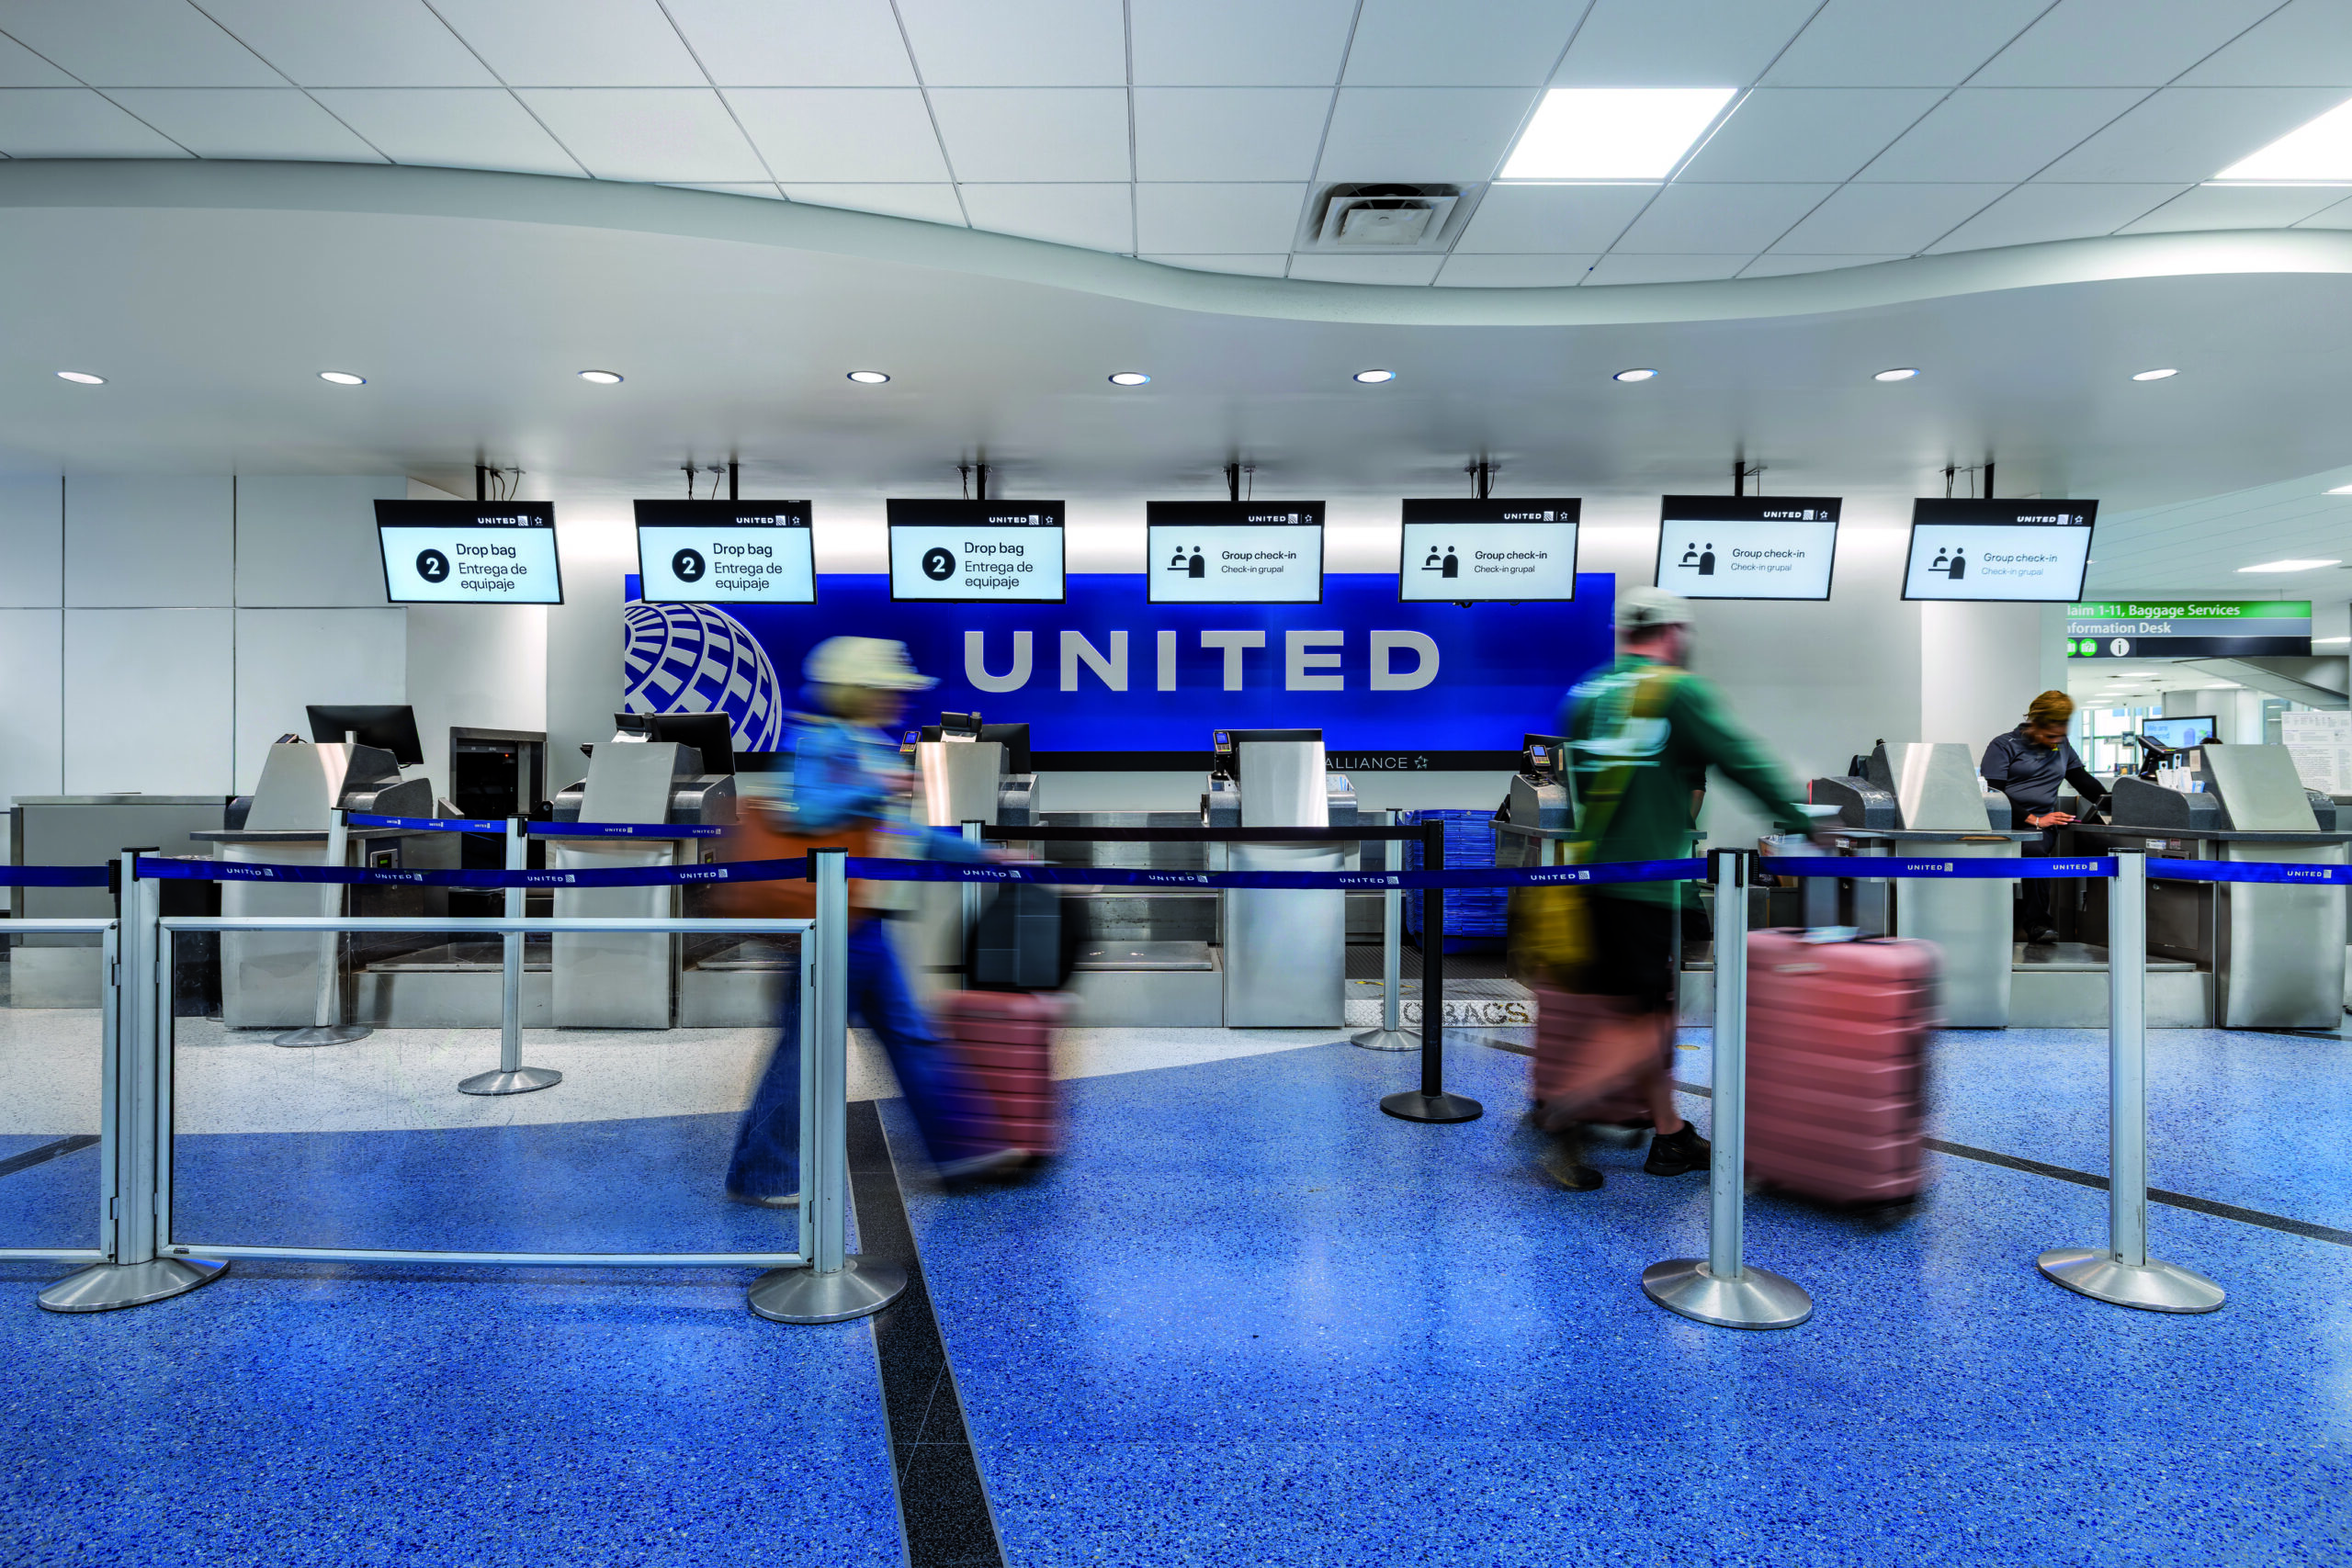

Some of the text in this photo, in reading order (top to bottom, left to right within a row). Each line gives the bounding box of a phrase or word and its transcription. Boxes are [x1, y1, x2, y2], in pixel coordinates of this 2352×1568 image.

[1763, 511, 1802, 519] UNITED
[457, 544, 515, 558] Drop bag
[714, 543, 772, 558] Drop bag
[965, 542, 1023, 556] Drop bag
[1733, 548, 1804, 559] Group check-in
[1222, 551, 1296, 562] Group check-in
[1476, 551, 1547, 561] Group check-in
[1984, 553, 2057, 564] Group check-in
[426, 558, 440, 574] 2
[458, 563, 526, 577] Entrega de
[683, 557, 695, 573] 2
[715, 562, 782, 577] Entrega de
[933, 556, 944, 572] 2
[966, 561, 1033, 576] Entrega de
[1510, 566, 1534, 574] grupal
[1731, 563, 1792, 574] Check-in grupal
[1221, 566, 1283, 576] Check-in grupal
[2018, 569, 2043, 577] grupal
[461, 579, 514, 592] equipaje
[716, 576, 769, 591] equipaje
[966, 577, 1019, 591] equipaje
[2067, 604, 2241, 617] laim 1-11, Baggage Services
[2067, 621, 2172, 634] formation Desk
[965, 630, 1440, 693] UNITED
[1325, 757, 1408, 769] ALLIANCE
[227, 868, 261, 876] UNITED
[964, 869, 1006, 878] UNITED
[1149, 872, 1194, 882] UNITED
[1531, 873, 1576, 881] UNITED
